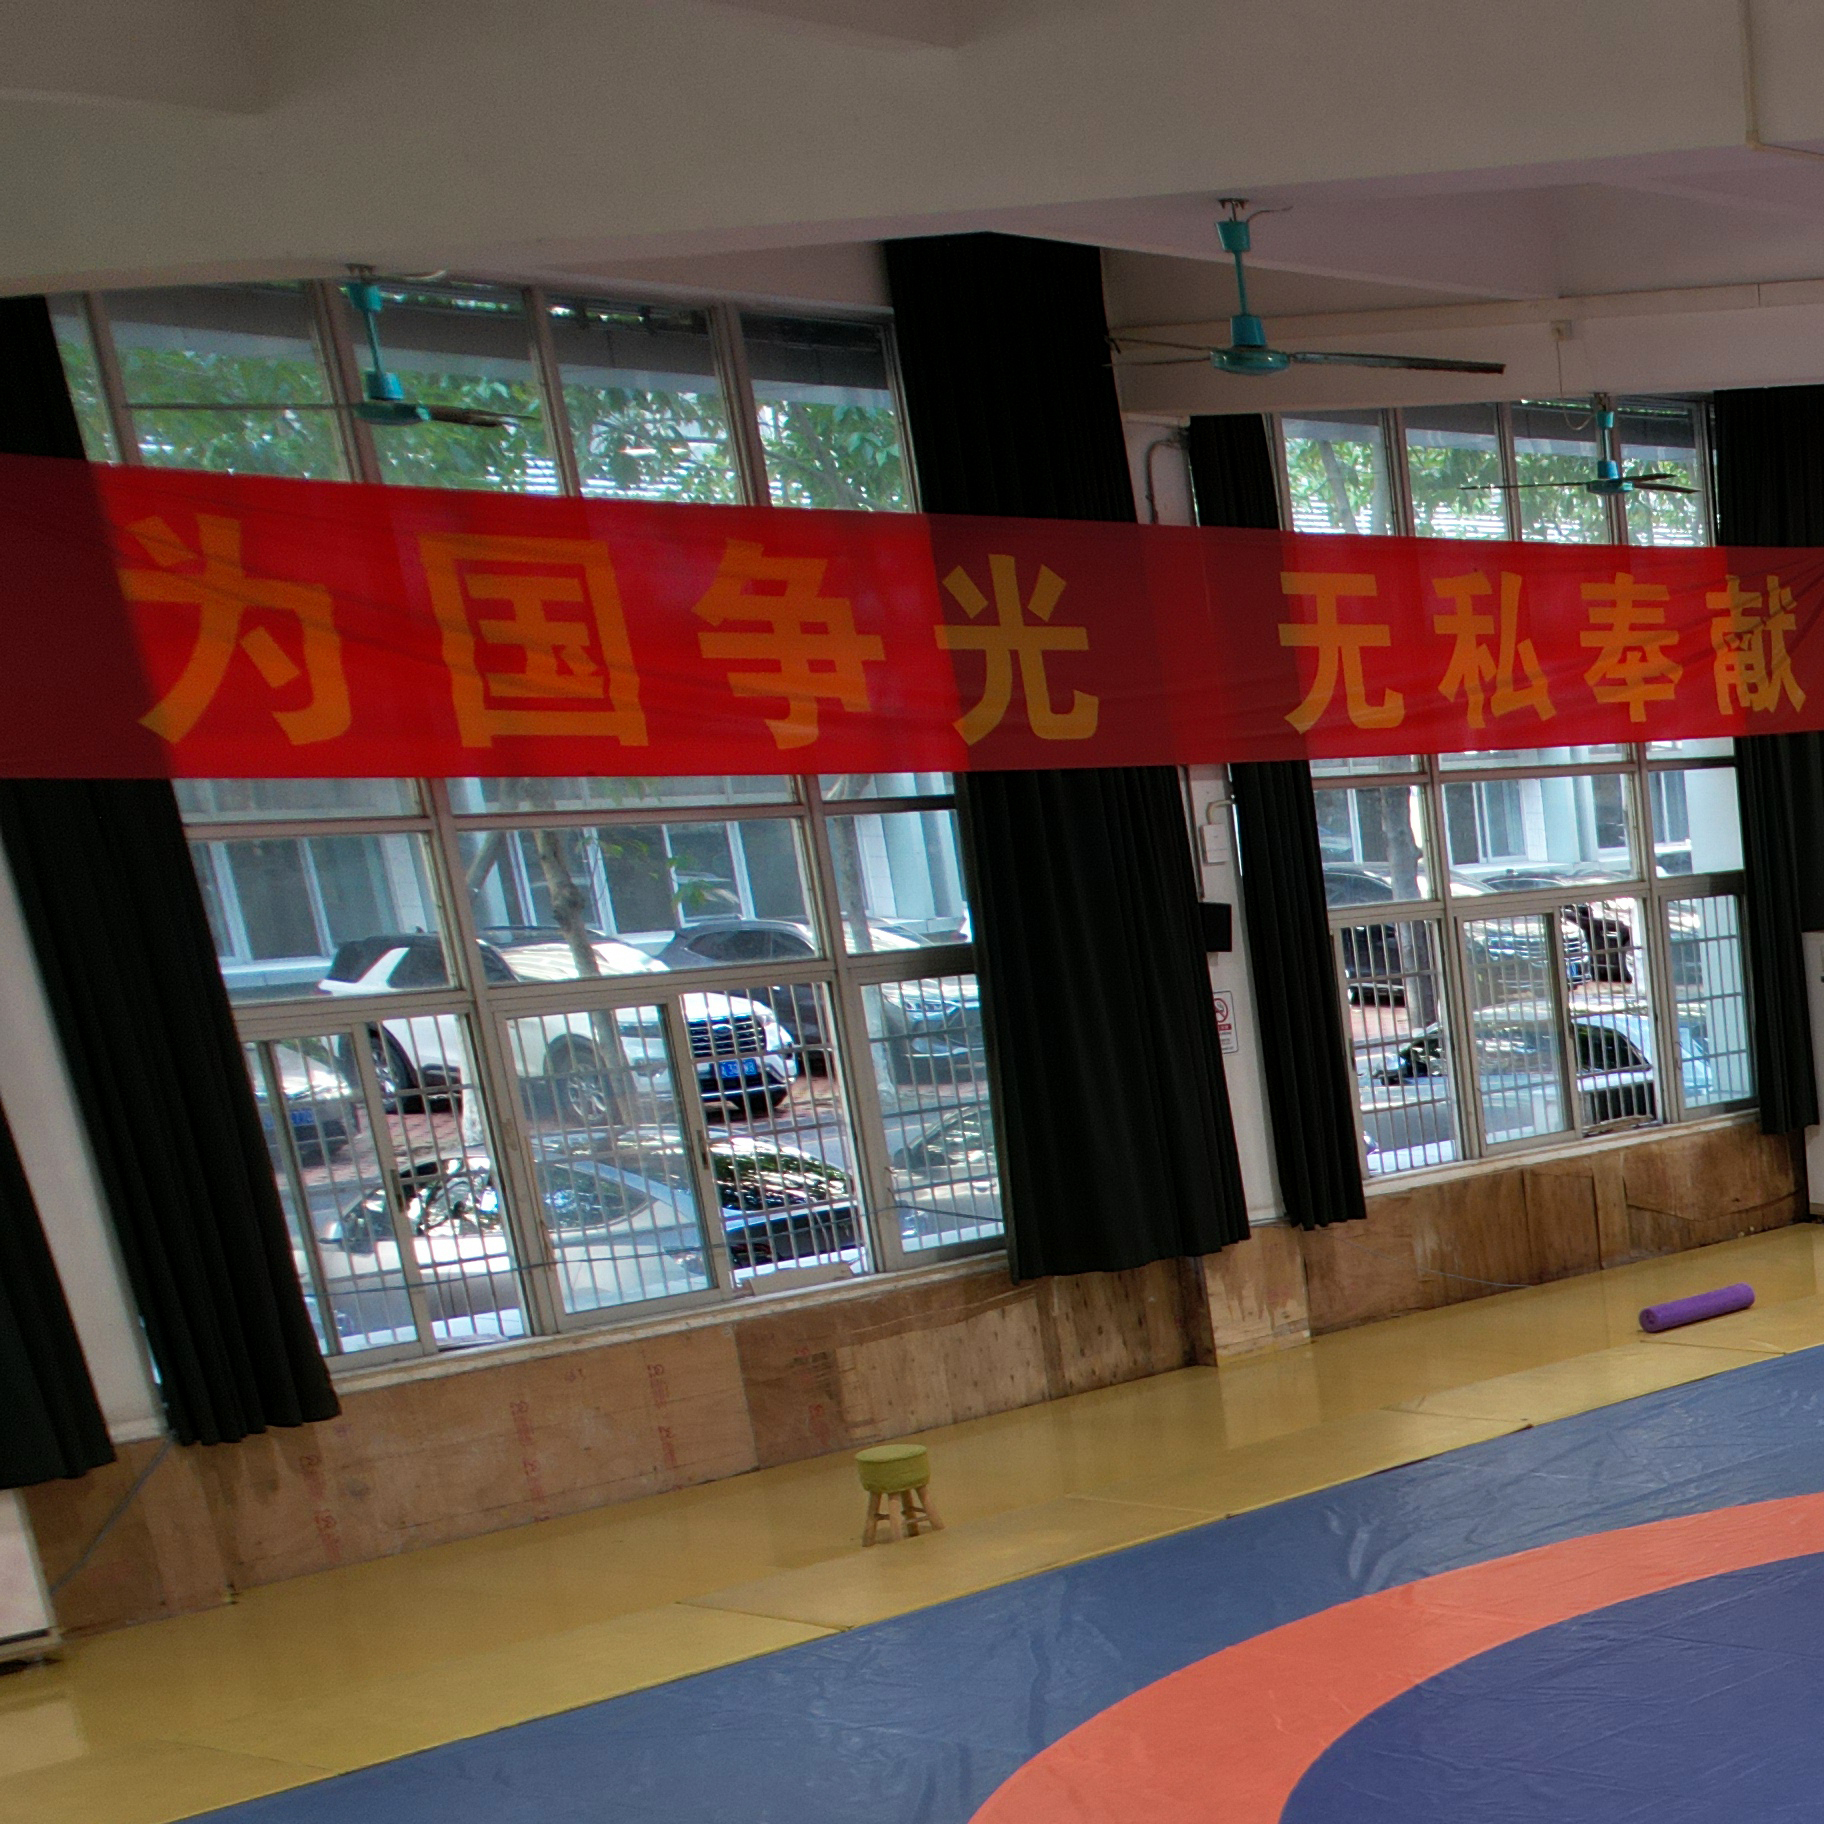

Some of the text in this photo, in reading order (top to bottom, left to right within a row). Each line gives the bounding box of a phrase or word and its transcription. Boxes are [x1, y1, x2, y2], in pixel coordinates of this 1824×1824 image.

[117, 514, 1806, 749] 为国争光 无私奉献
